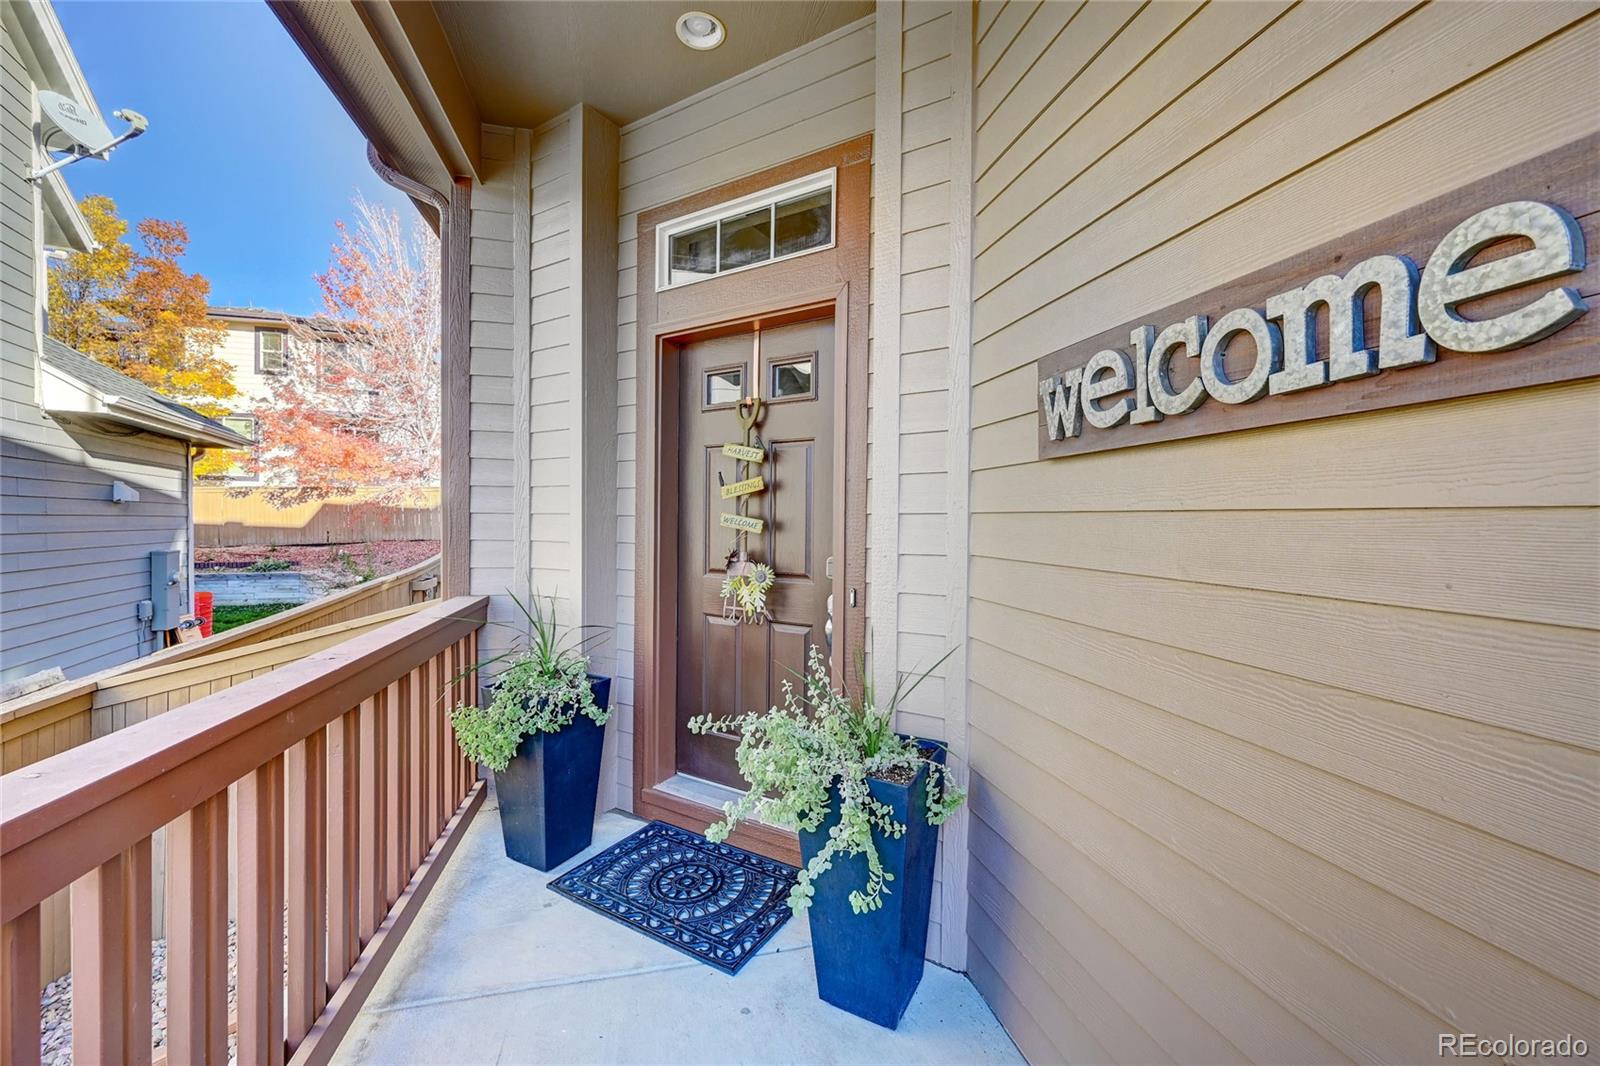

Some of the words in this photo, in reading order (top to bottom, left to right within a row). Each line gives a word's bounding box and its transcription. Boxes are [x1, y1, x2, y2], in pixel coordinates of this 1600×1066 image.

[1039, 200, 1589, 441] welcome
[727, 445, 760, 459] HARVEST
[723, 515, 758, 529] WELCOME
